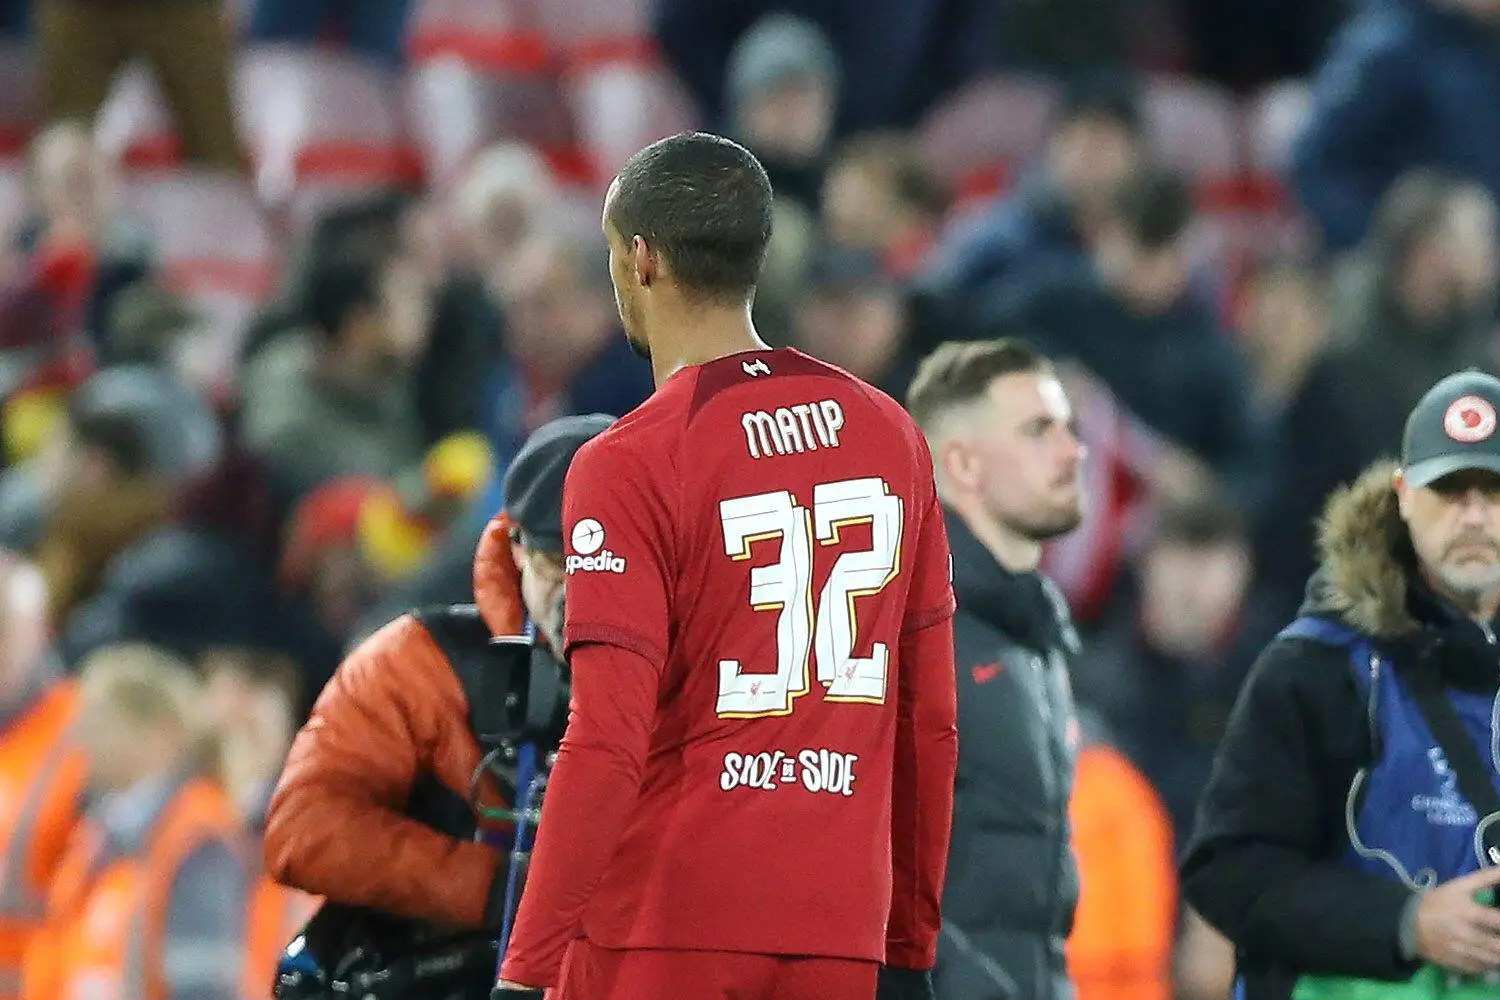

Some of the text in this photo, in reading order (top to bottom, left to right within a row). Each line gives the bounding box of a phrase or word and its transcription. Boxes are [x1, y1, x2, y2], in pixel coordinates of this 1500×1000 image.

[742, 399, 844, 458] MATIP
[565, 550, 625, 575] pedia
[716, 477, 904, 719] 32
[720, 750, 785, 791] SIDE
[798, 748, 858, 796] SIDE
